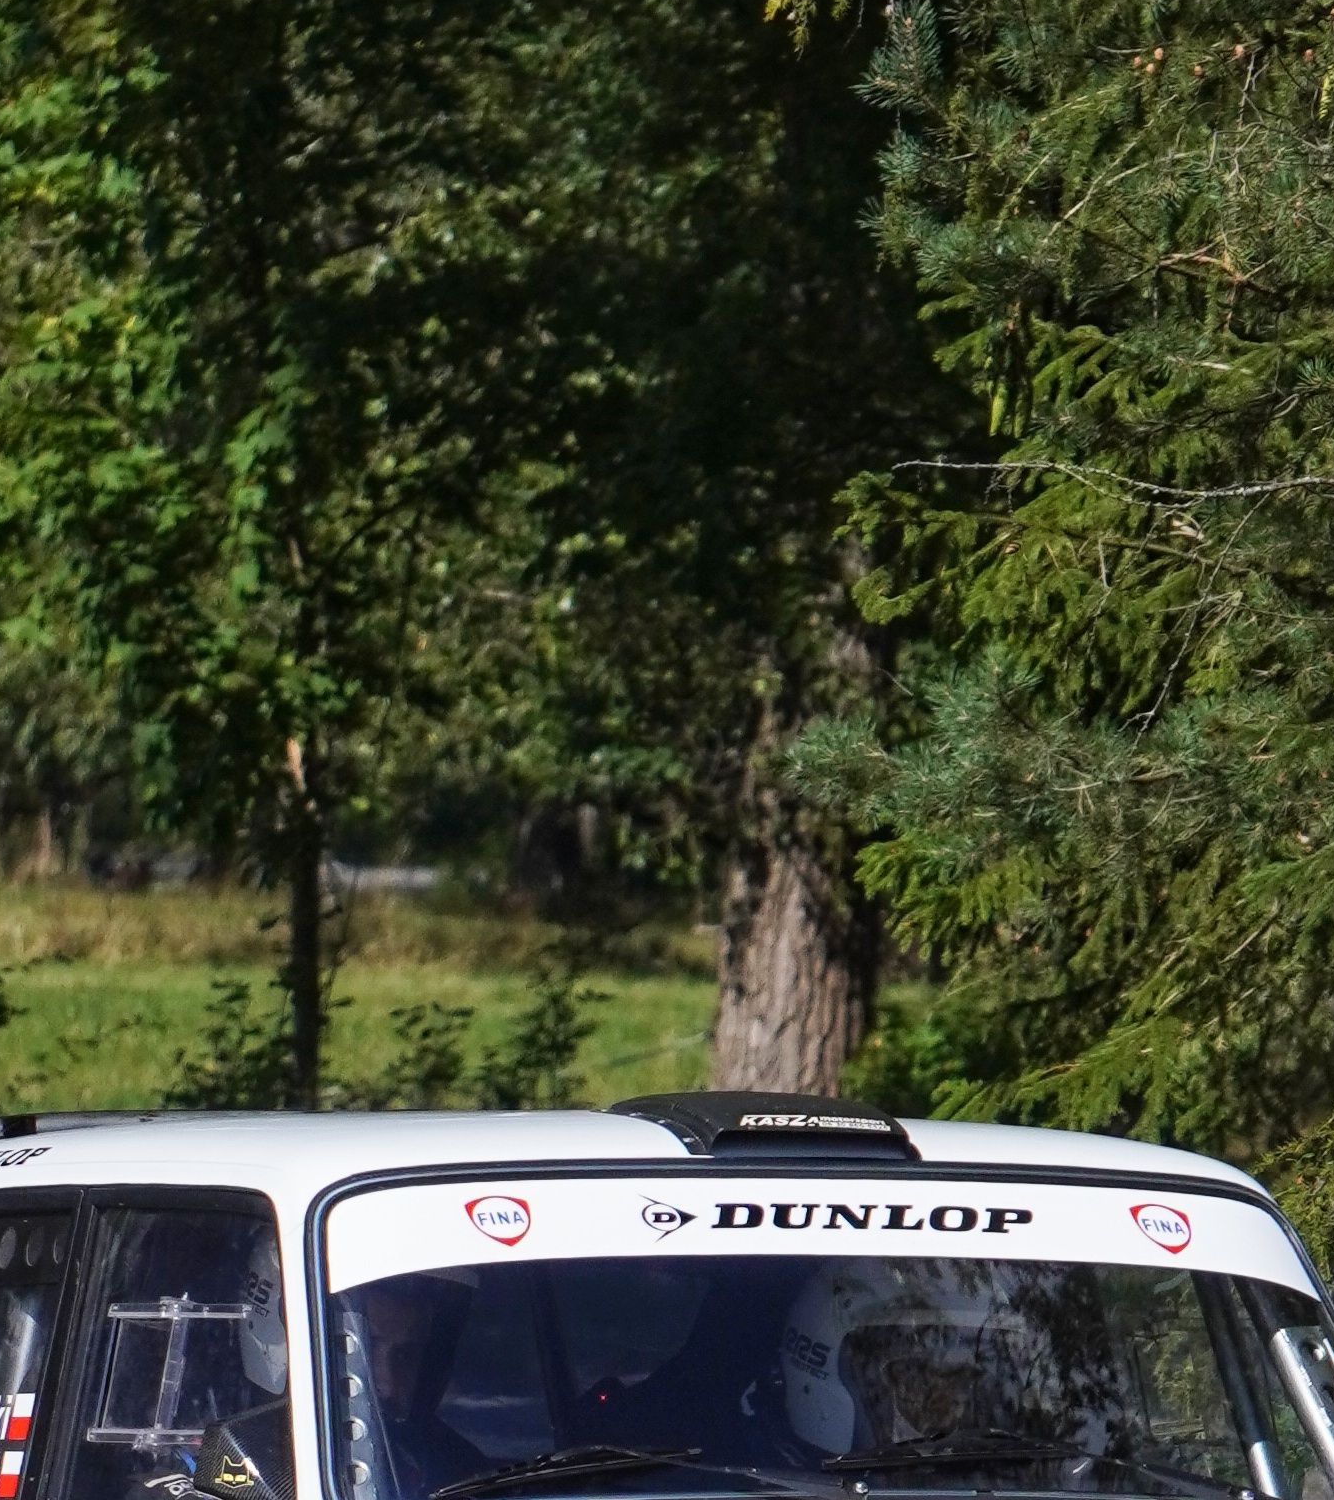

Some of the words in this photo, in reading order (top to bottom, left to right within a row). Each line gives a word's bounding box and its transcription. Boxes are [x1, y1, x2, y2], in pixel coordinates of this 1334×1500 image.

[477, 1210, 526, 1226] FINA
[711, 1203, 1033, 1233] DUNLOP
[1141, 1217, 1186, 1236] FINA
